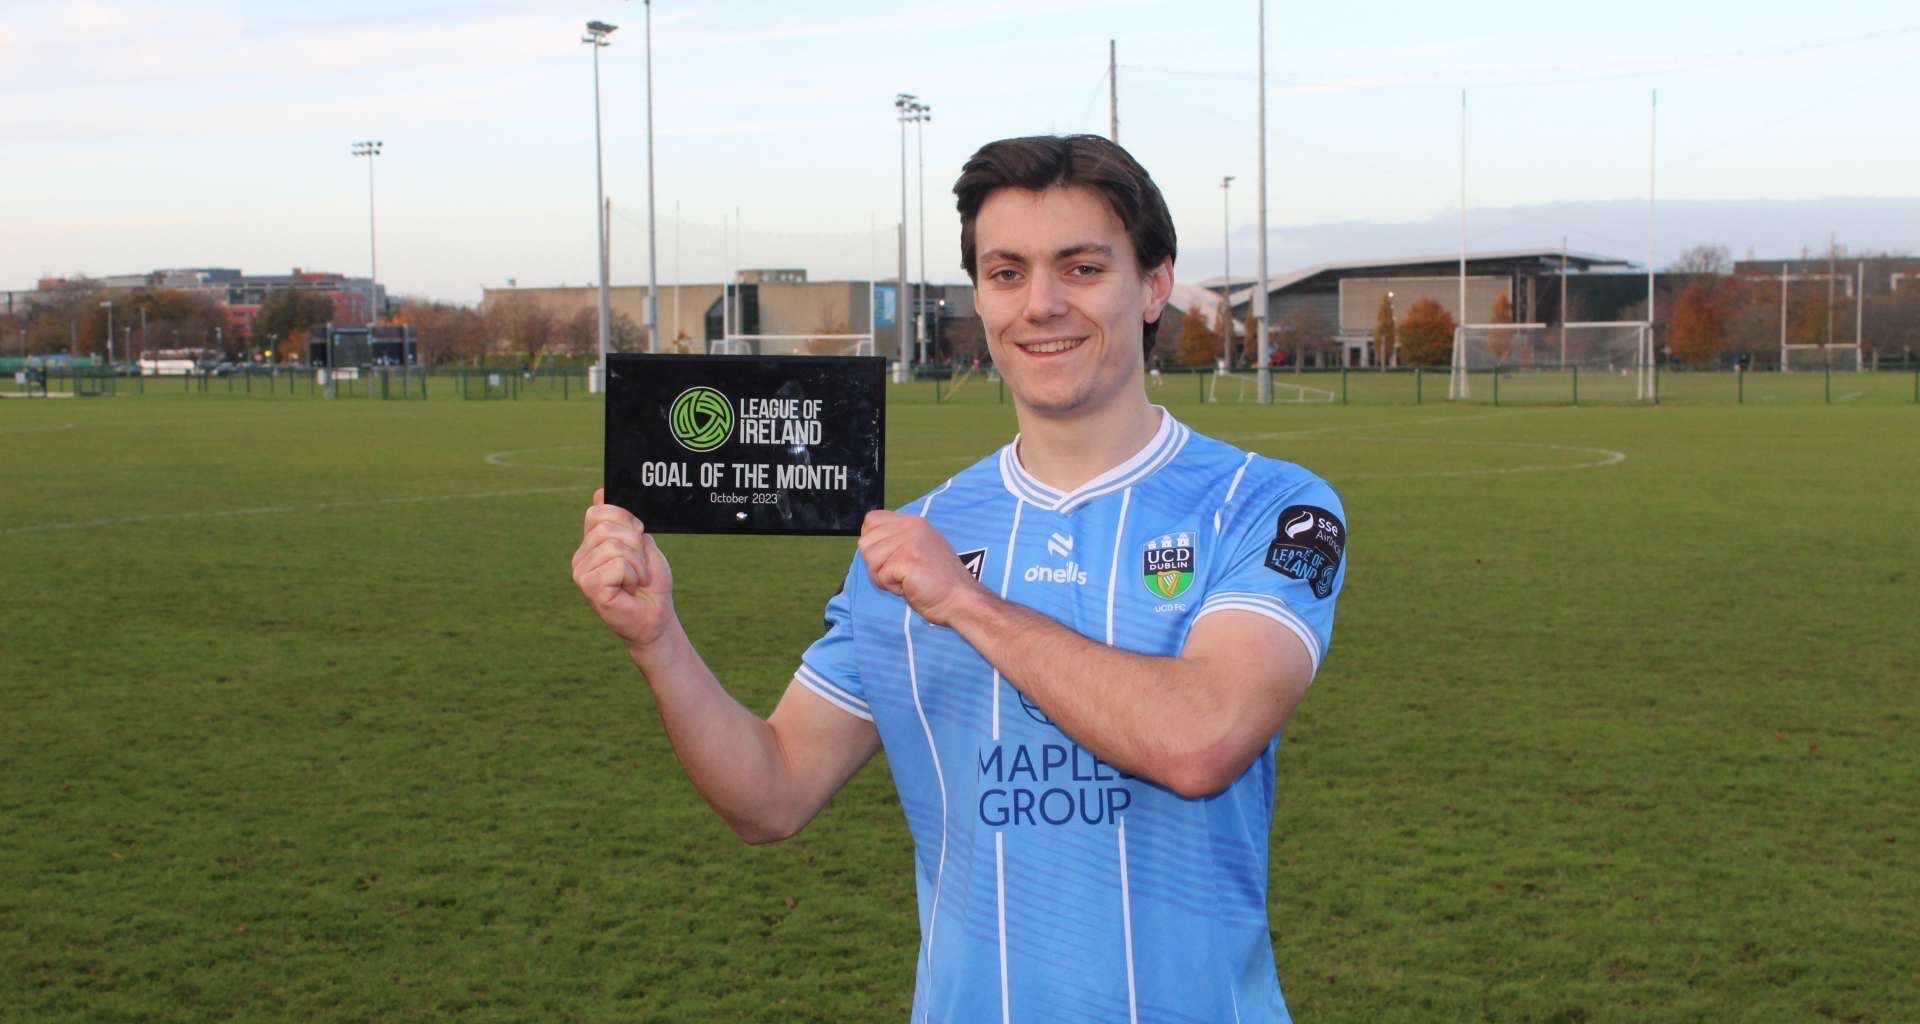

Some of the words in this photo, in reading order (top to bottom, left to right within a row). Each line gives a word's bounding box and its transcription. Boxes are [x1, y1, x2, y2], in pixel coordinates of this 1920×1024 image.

[740, 398, 799, 419] LEAGUE
[802, 400, 823, 420] OF
[739, 419, 822, 446] IRELAND
[641, 461, 693, 488] GOAL
[700, 462, 725, 489] OF
[731, 463, 770, 490] THE
[776, 464, 848, 491] MONTH
[710, 492, 749, 504] October
[752, 493, 778, 505] 2023
[1147, 548, 1190, 564] UCD
[1149, 561, 1188, 571] DUBLIN
[1154, 604, 1173, 612] UCD
[1174, 603, 1186, 611] FC
[978, 744, 1132, 784] MAPLE
[979, 787, 1132, 826] GROUP
